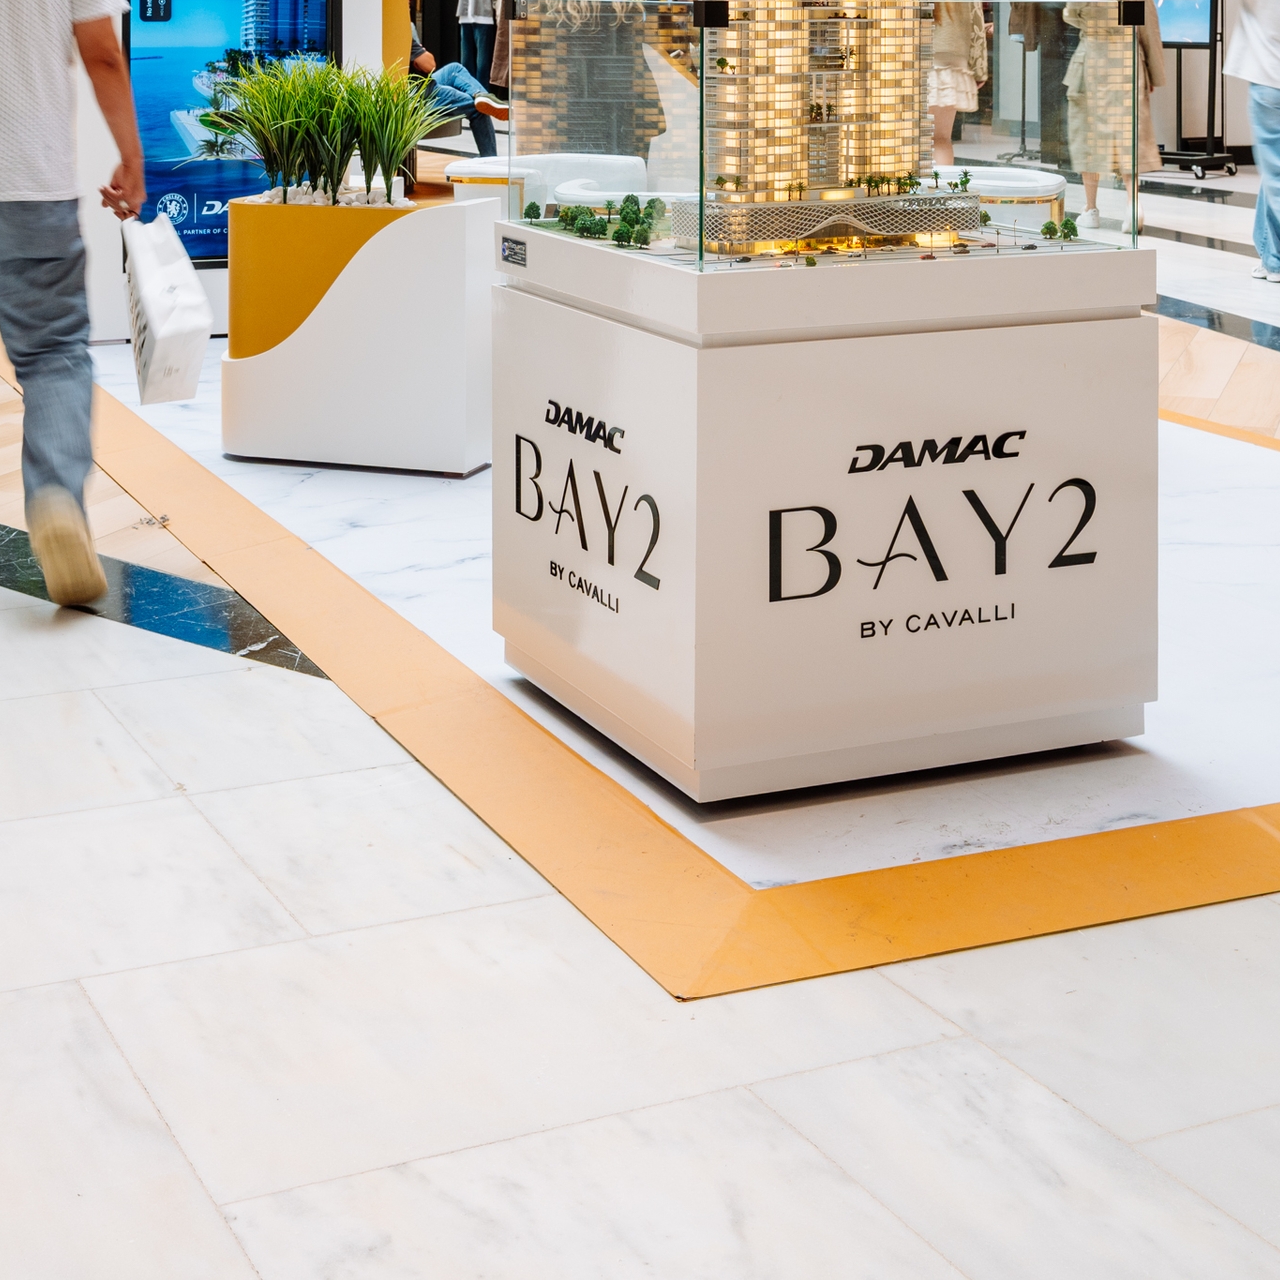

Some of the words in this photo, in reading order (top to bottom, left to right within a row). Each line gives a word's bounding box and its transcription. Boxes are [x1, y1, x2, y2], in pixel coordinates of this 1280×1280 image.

[146, 7, 153, 17] No
[545, 399, 625, 454] DAMAC
[847, 430, 1027, 474] DAMAC
[549, 560, 565, 581] BY
[568, 569, 619, 614] CAVALLI
[860, 618, 893, 639] BY
[906, 602, 1016, 634] CAVALLI
